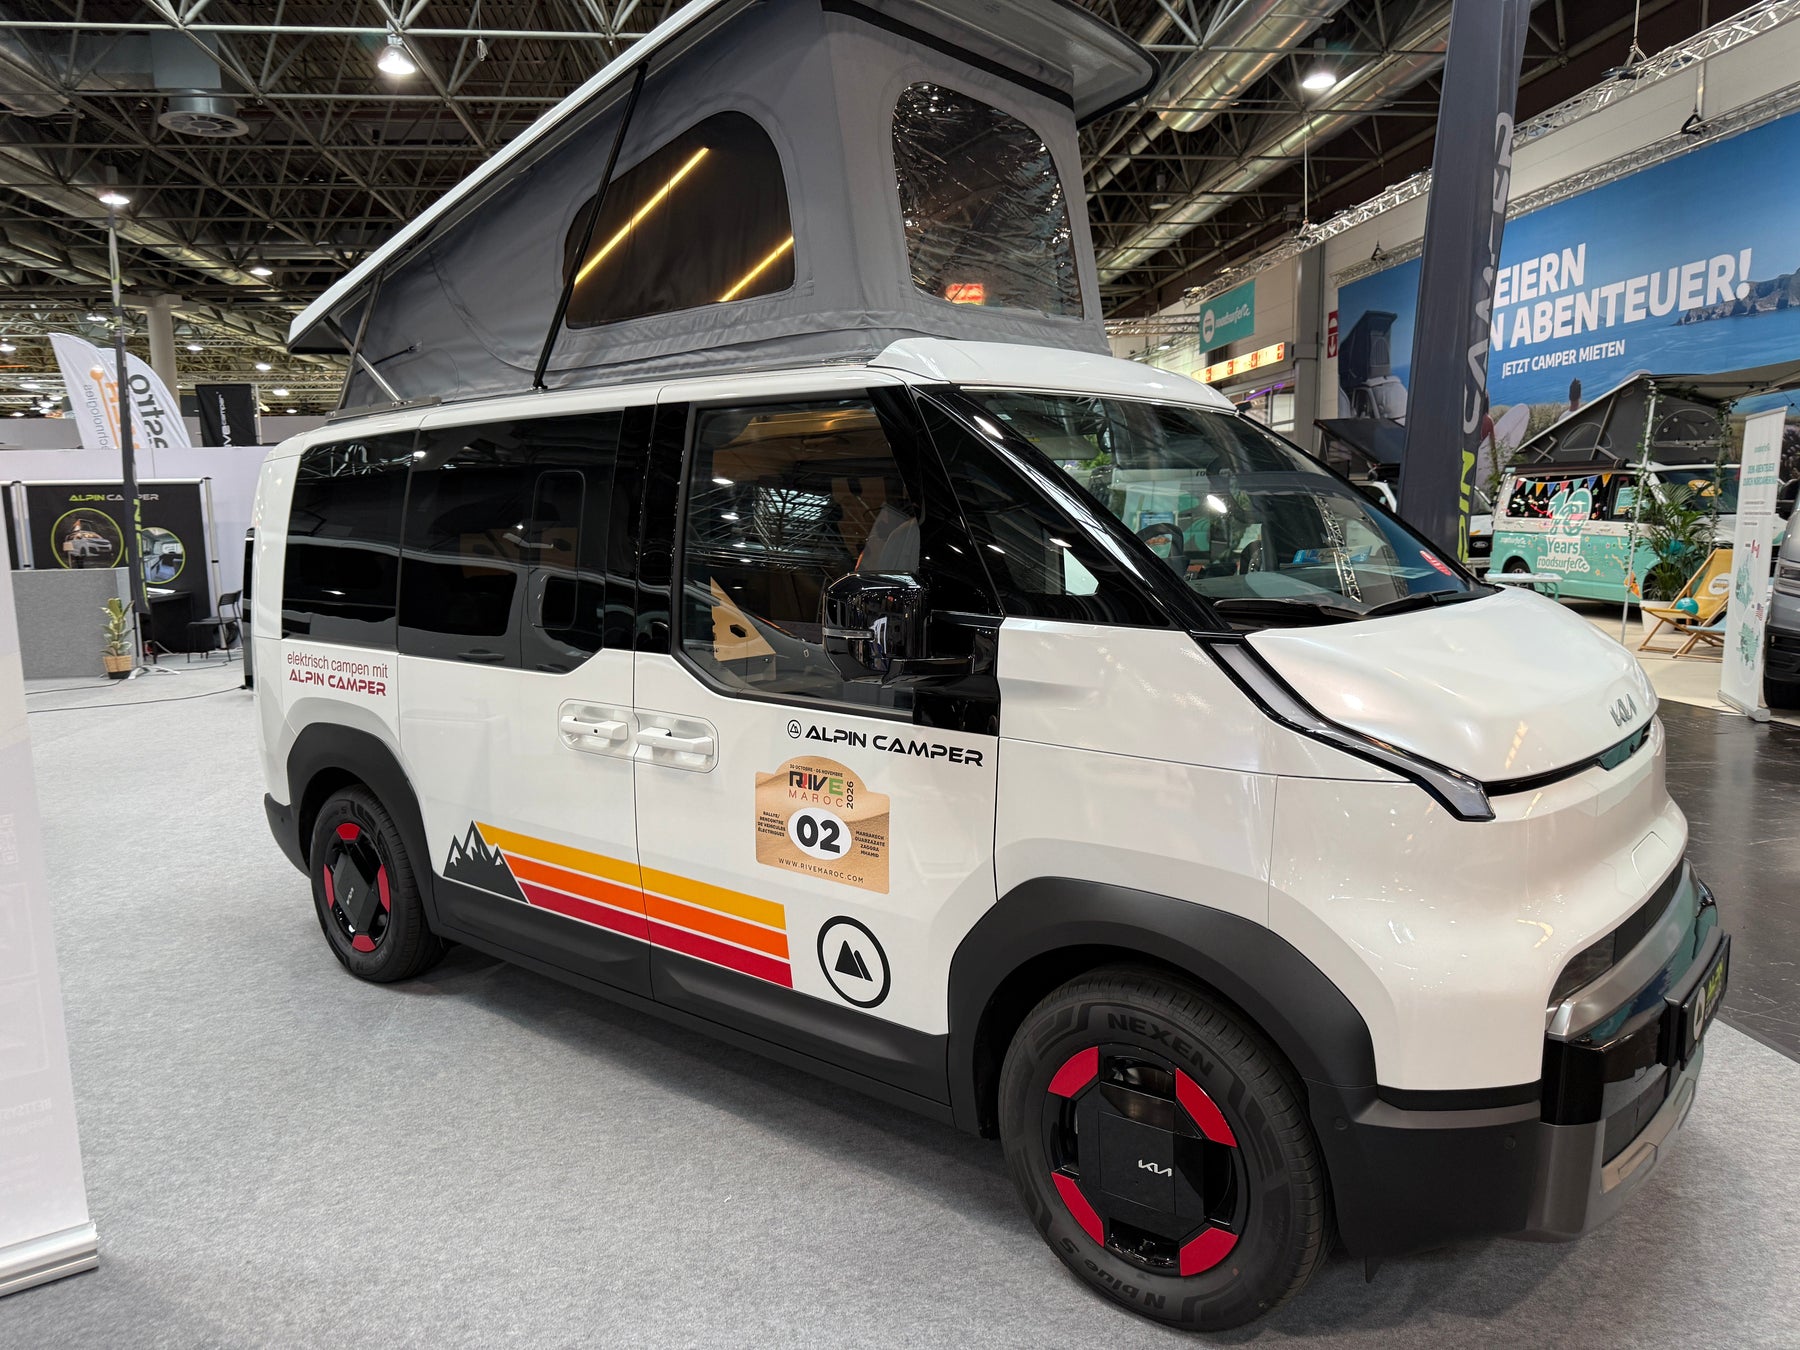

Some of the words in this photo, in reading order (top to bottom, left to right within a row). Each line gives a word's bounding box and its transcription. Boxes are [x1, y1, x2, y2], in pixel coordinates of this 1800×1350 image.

[1510, 248, 1752, 348] ABENTEUER!
[1502, 357, 1530, 379] JETZT
[1532, 350, 1577, 370] CAMPER
[1579, 340, 1625, 361] MIETEN
[106, 493, 160, 501] CAPER
[1547, 537, 1579, 554] Years
[287, 651, 329, 670] elektrisch
[331, 659, 369, 677] campen
[372, 663, 389, 679] mit
[289, 668, 325, 686] ALPIN
[327, 675, 386, 697] CAMPER
[805, 725, 867, 748] ALPIN
[872, 735, 984, 767] CAMPER
[821, 769, 843, 778] NOVEMBRE
[788, 789, 844, 808] MAROC
[846, 781, 854, 809] 2026
[796, 814, 840, 854] 02
[778, 858, 864, 884] WWW.RIVEMAROC.COM
[1106, 1011, 1215, 1078] NEXEN
[1084, 1258, 1140, 1299] blue
[1144, 1292, 1166, 1310] N
